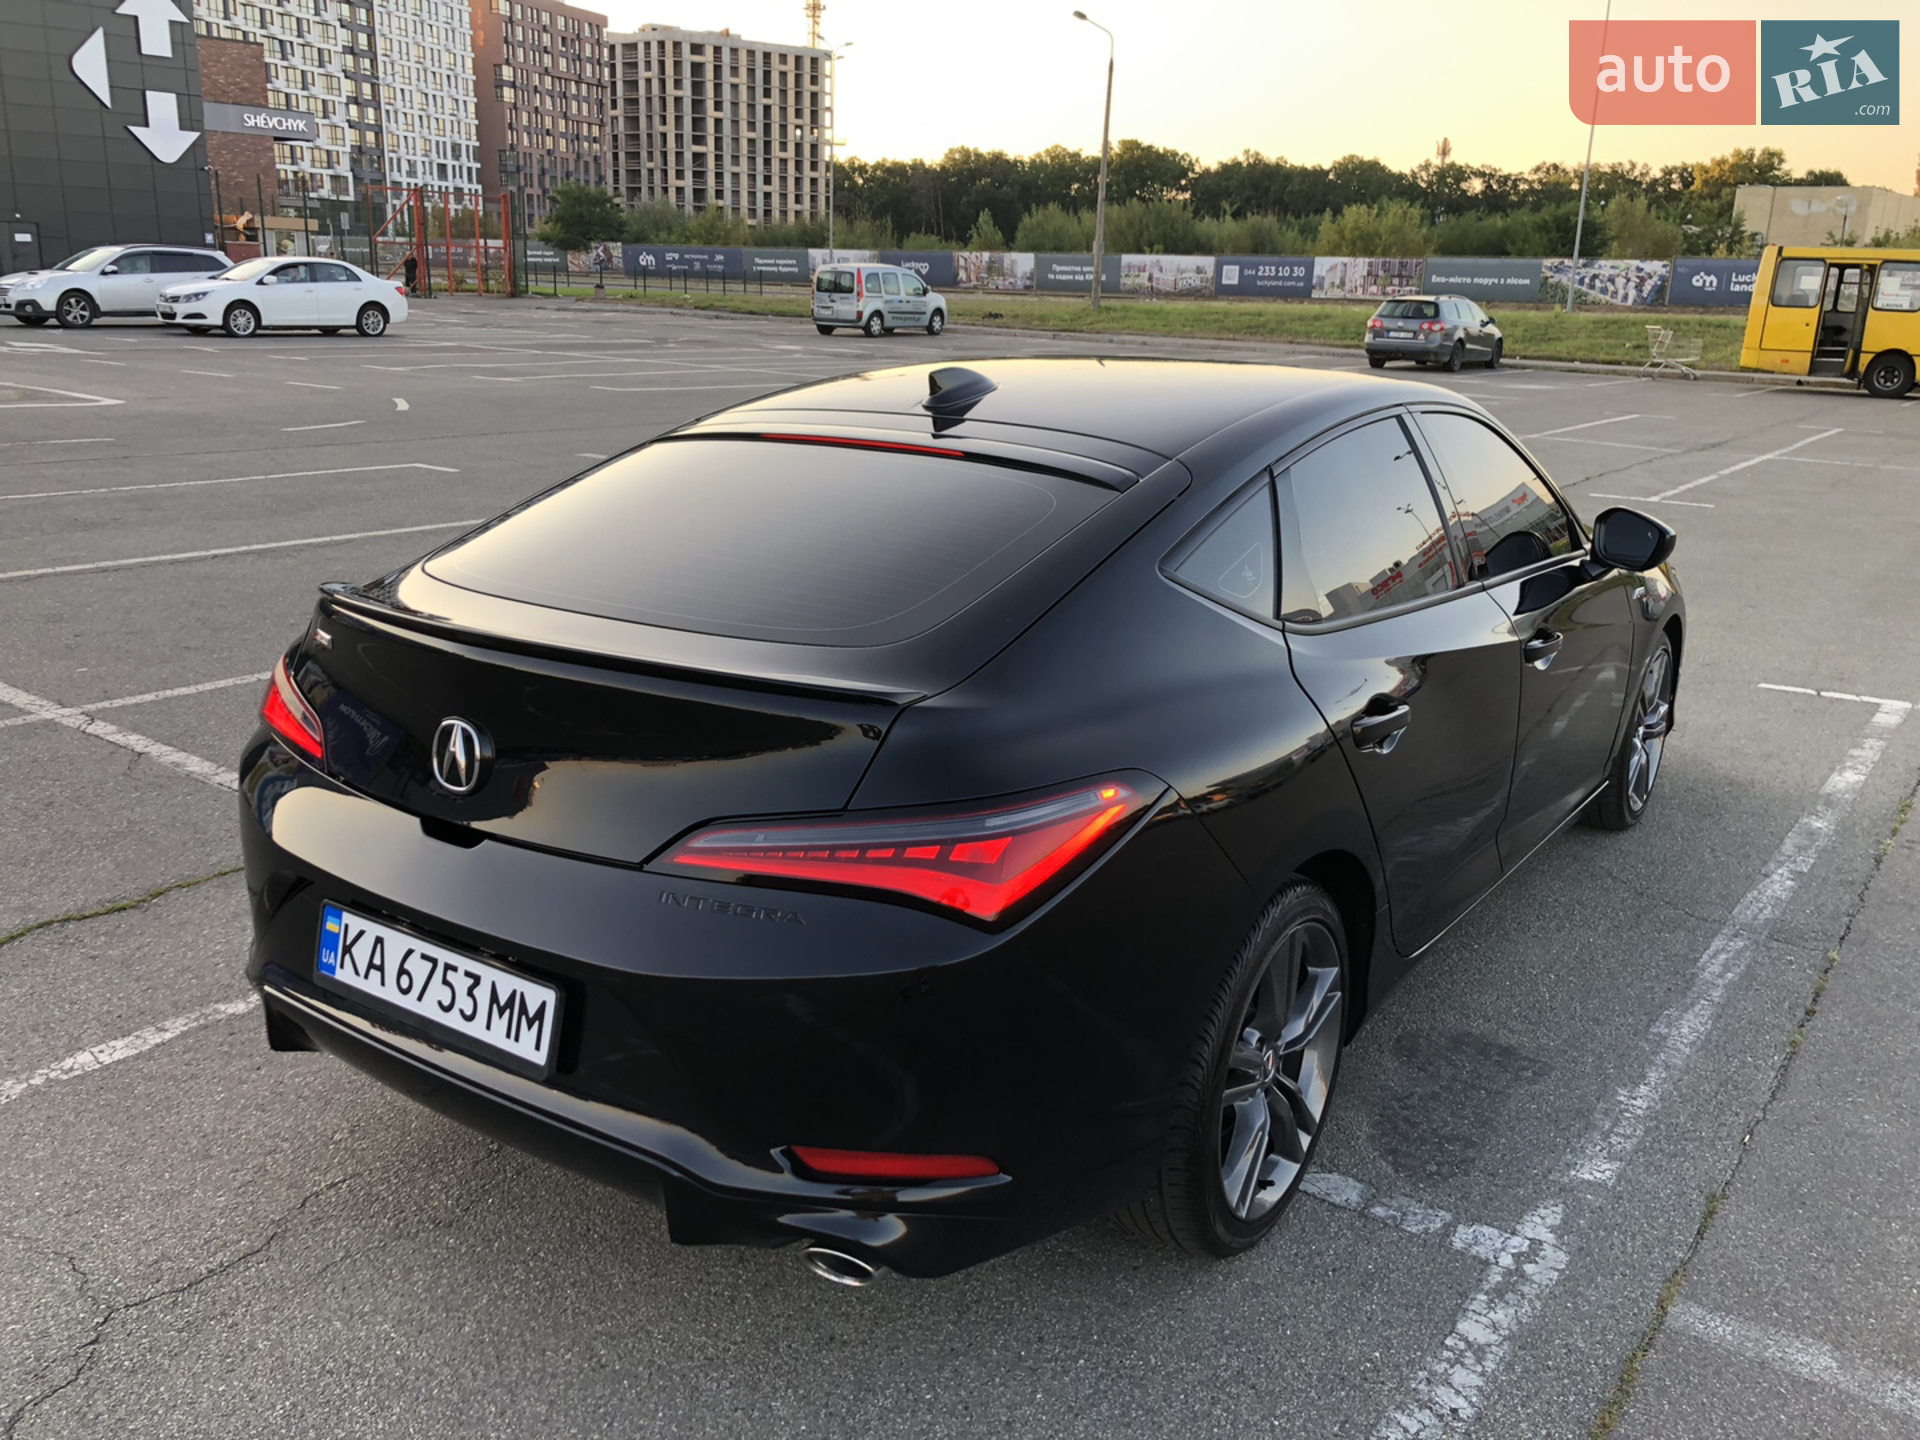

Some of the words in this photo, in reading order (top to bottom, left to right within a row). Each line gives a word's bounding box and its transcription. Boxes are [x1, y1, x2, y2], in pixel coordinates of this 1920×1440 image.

[1243, 268, 1256, 276] 044
[1257, 265, 1276, 276] 233
[1278, 266, 1290, 277] 10
[1292, 266, 1305, 277] 30
[1256, 279, 1304, 287] luckyland.com.ua
[1431, 274, 1471, 284] Еко-місто
[1473, 276, 1498, 286] поруч
[1506, 276, 1530, 285] лісом
[659, 890, 807, 925] INTEGRA
[322, 947, 336, 967] UA
